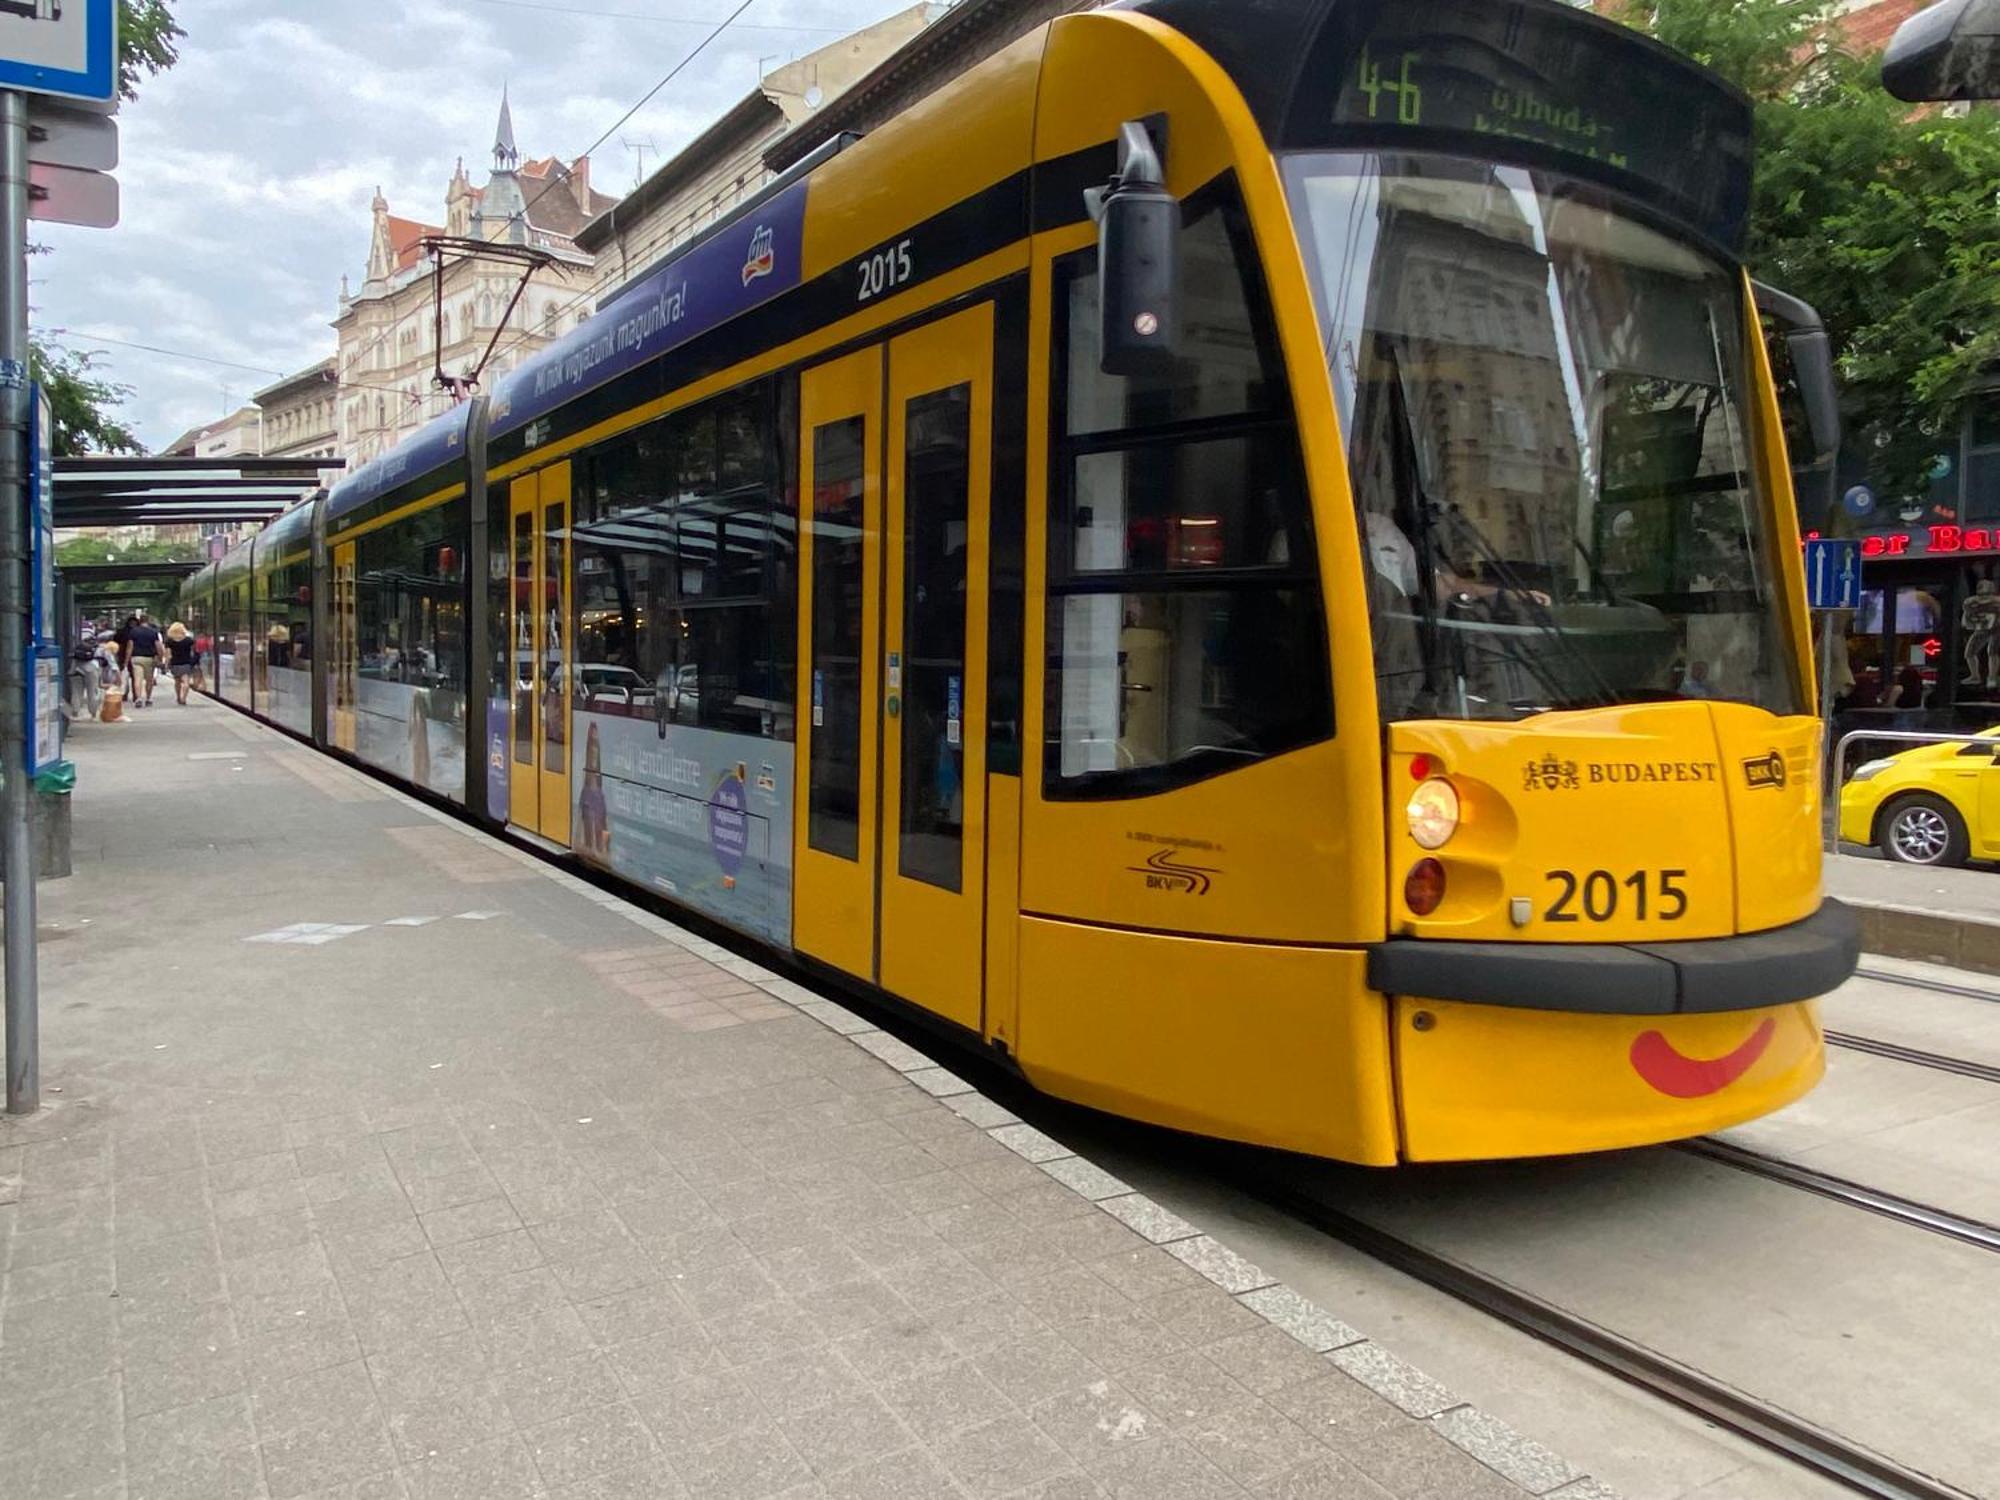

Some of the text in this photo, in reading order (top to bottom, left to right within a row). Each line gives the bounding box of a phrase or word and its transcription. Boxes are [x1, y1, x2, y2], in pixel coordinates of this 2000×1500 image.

[858, 238, 911, 301] 2015
[616, 279, 688, 352] magunkra!
[1926, 525, 2000, 553] Ba
[1588, 761, 1716, 784] BUDAPEST
[1544, 868, 1688, 922] 2015
